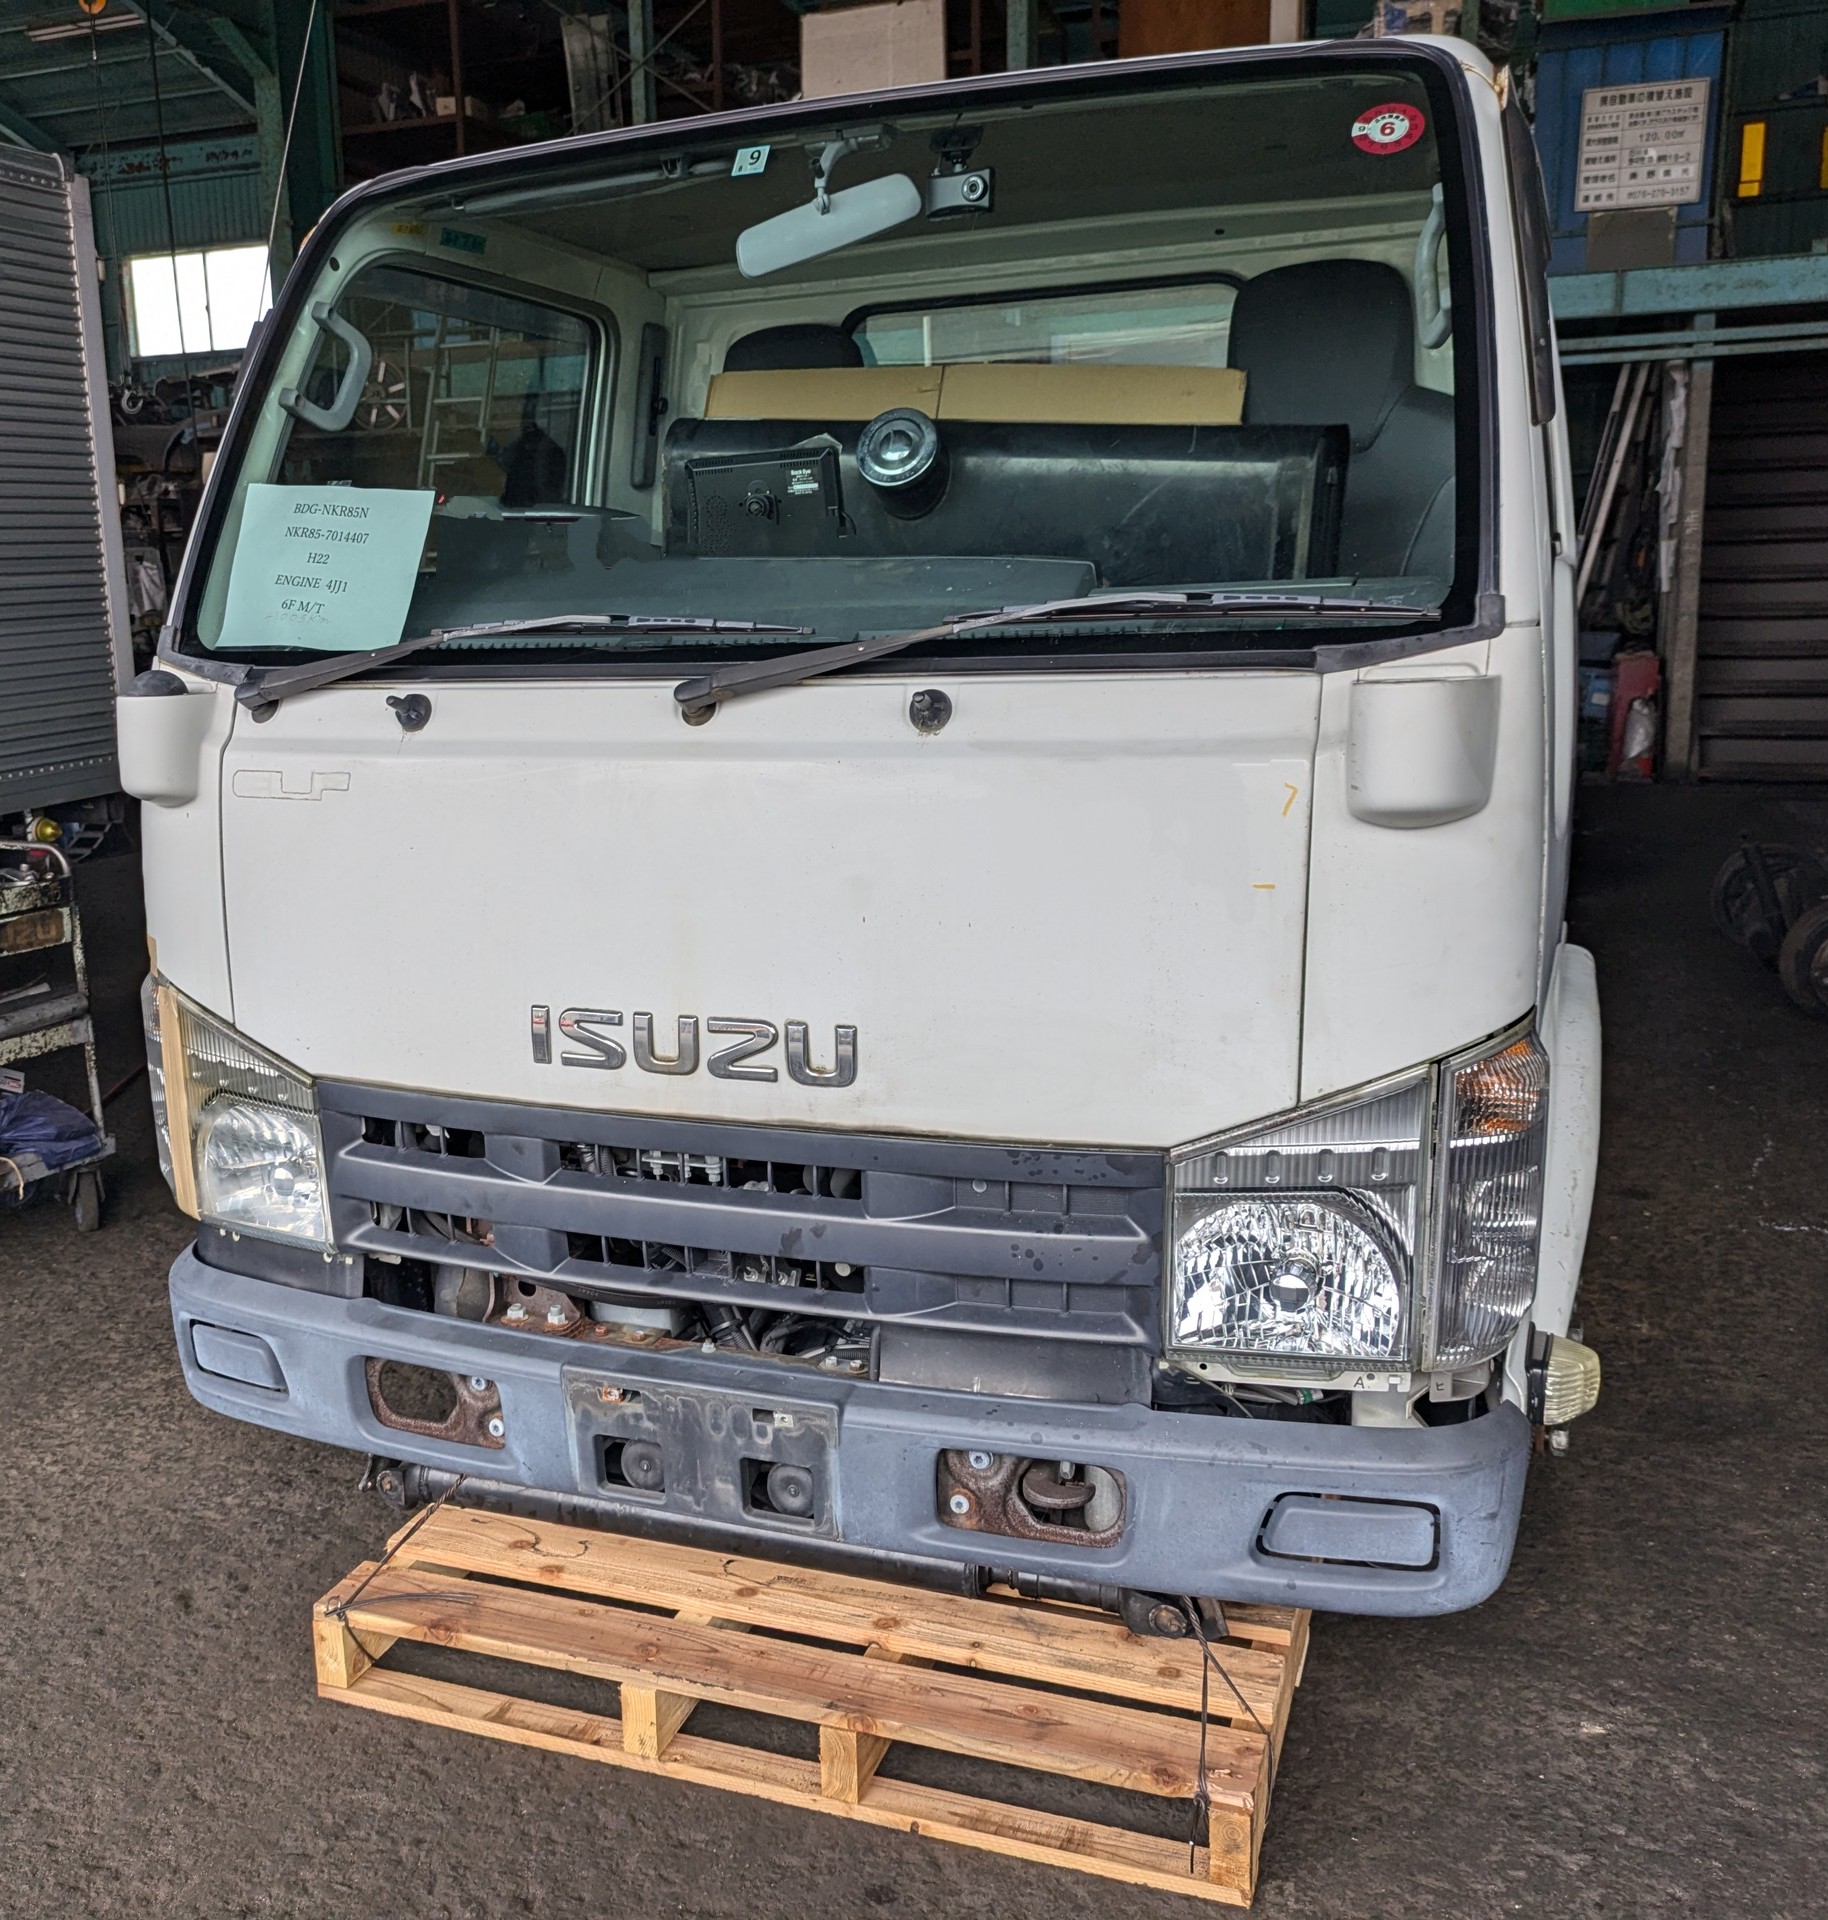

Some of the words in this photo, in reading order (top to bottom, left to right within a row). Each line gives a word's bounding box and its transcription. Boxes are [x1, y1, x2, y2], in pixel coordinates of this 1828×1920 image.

[1380, 121, 1396, 137] 6
[748, 149, 762, 166] 9
[293, 503, 369, 519] BDG-NKR85N
[284, 526, 369, 544] NKR85-7014407
[307, 552, 330, 565] H22
[274, 574, 321, 589] ENGINE
[326, 580, 348, 593] 4JJ1
[281, 599, 296, 610] 6F
[297, 601, 325, 614] M/T
[531, 1004, 858, 1088] ISUZU
[1353, 1376, 1365, 1389] A
